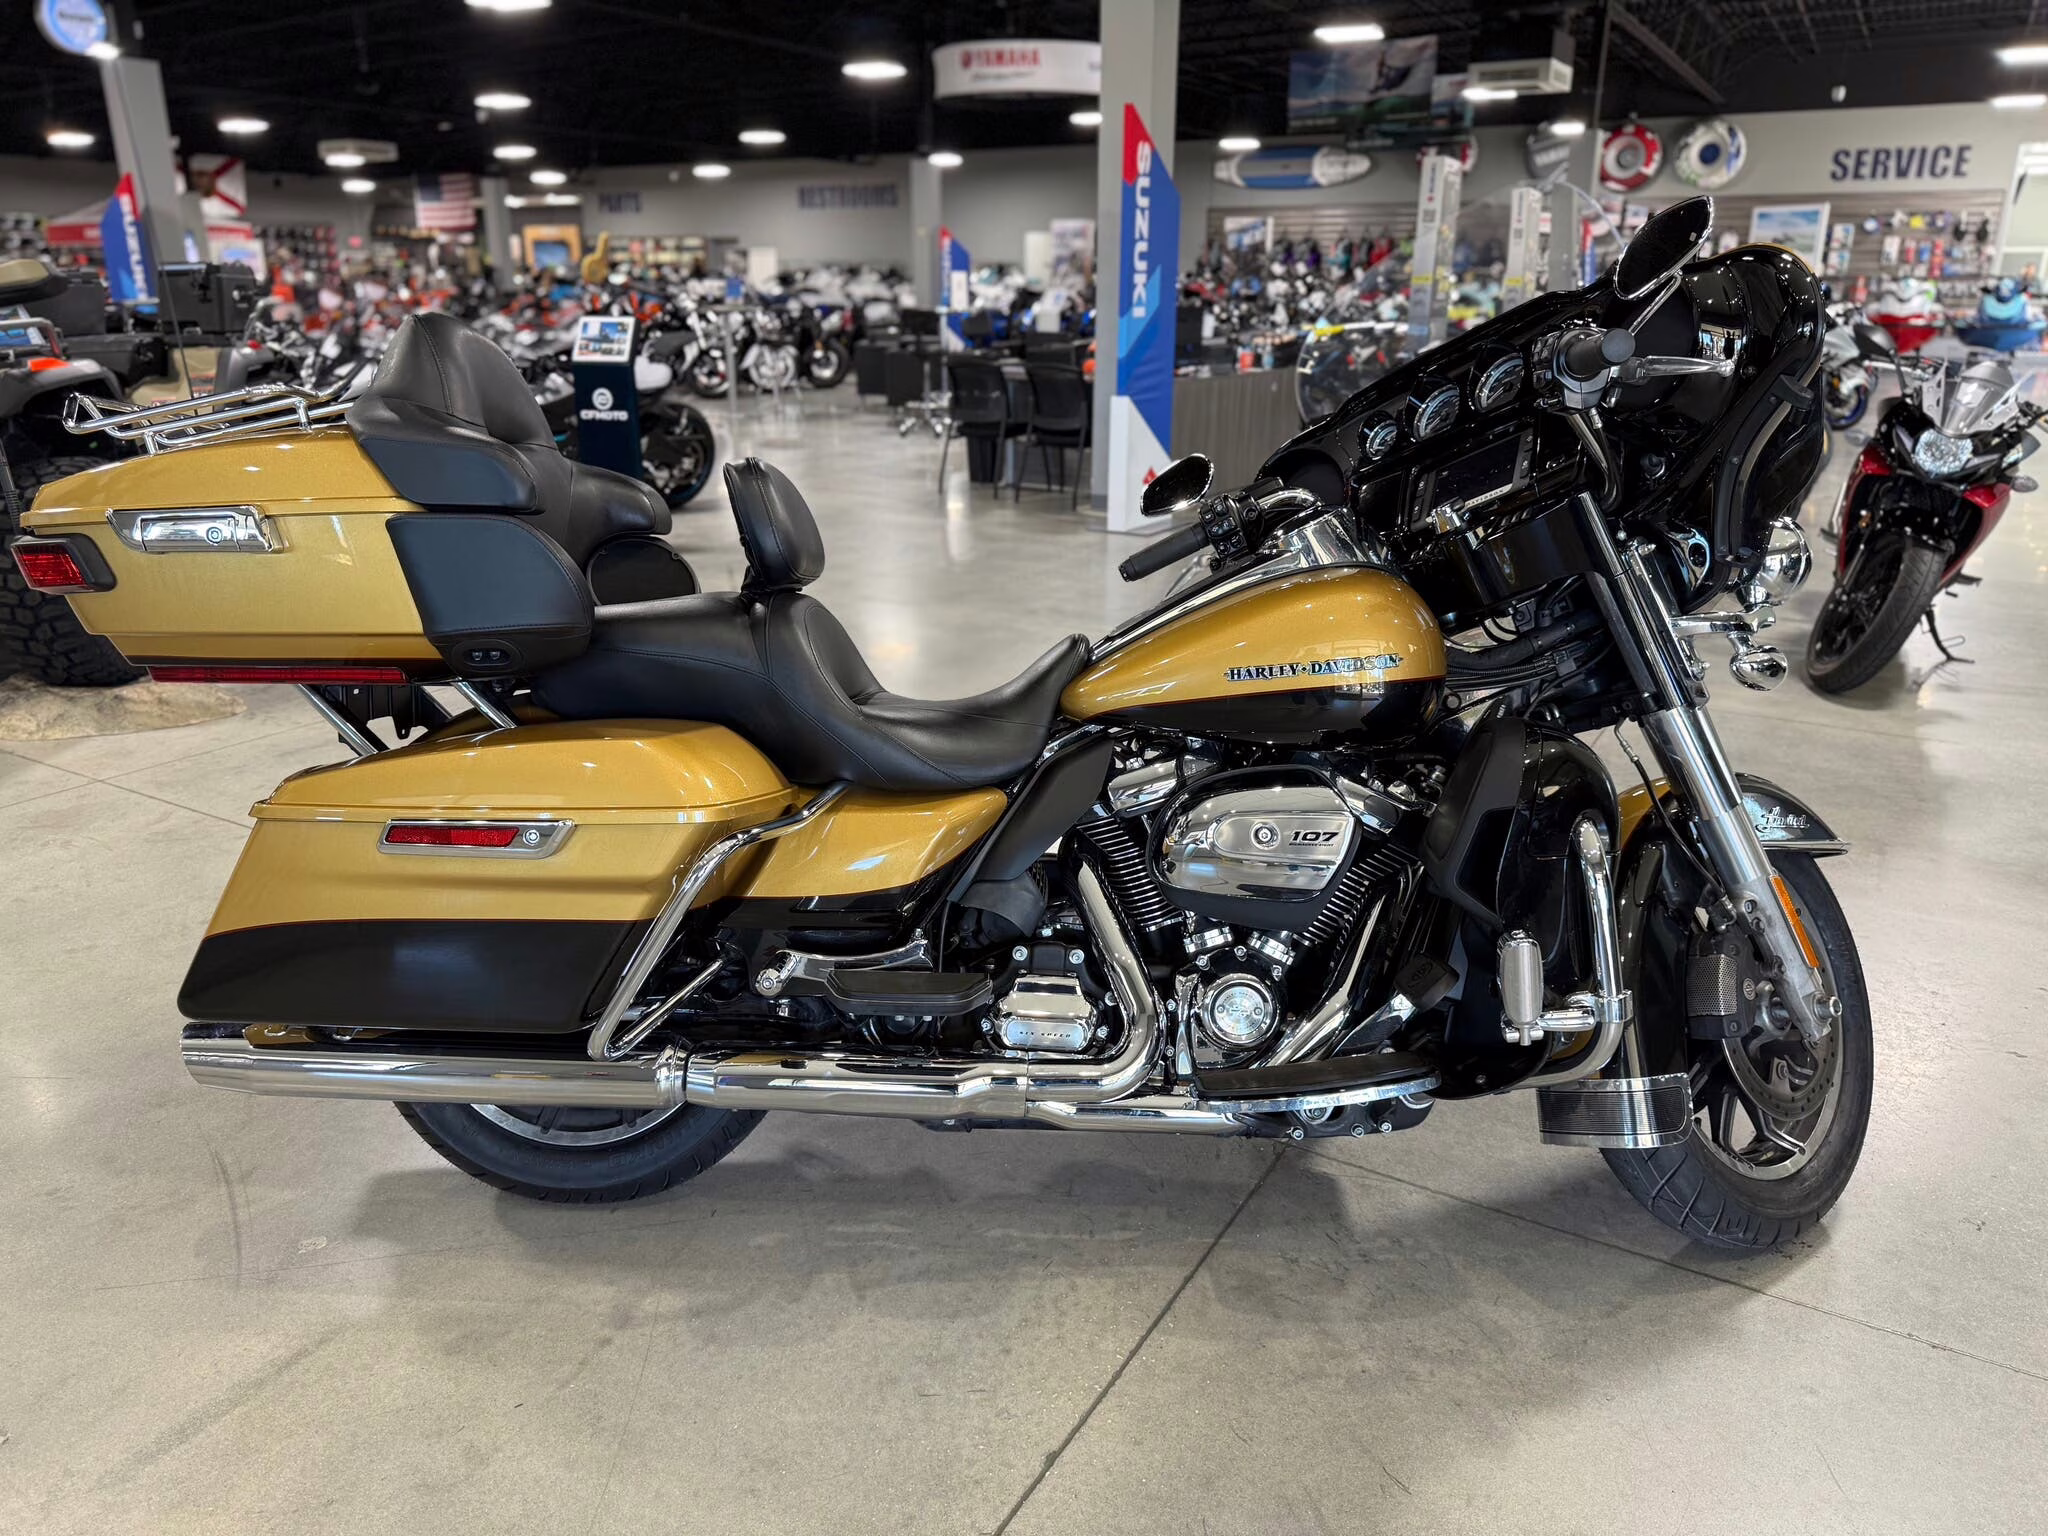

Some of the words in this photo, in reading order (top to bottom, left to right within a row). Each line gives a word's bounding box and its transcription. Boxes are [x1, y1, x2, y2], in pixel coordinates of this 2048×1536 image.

[974, 48, 1041, 68] YAMAHA
[1830, 145, 1973, 182] SERVICE
[1131, 140, 1153, 318] SUZUKI
[580, 409, 629, 421] CFMOTO
[1291, 831, 1340, 842] 107
